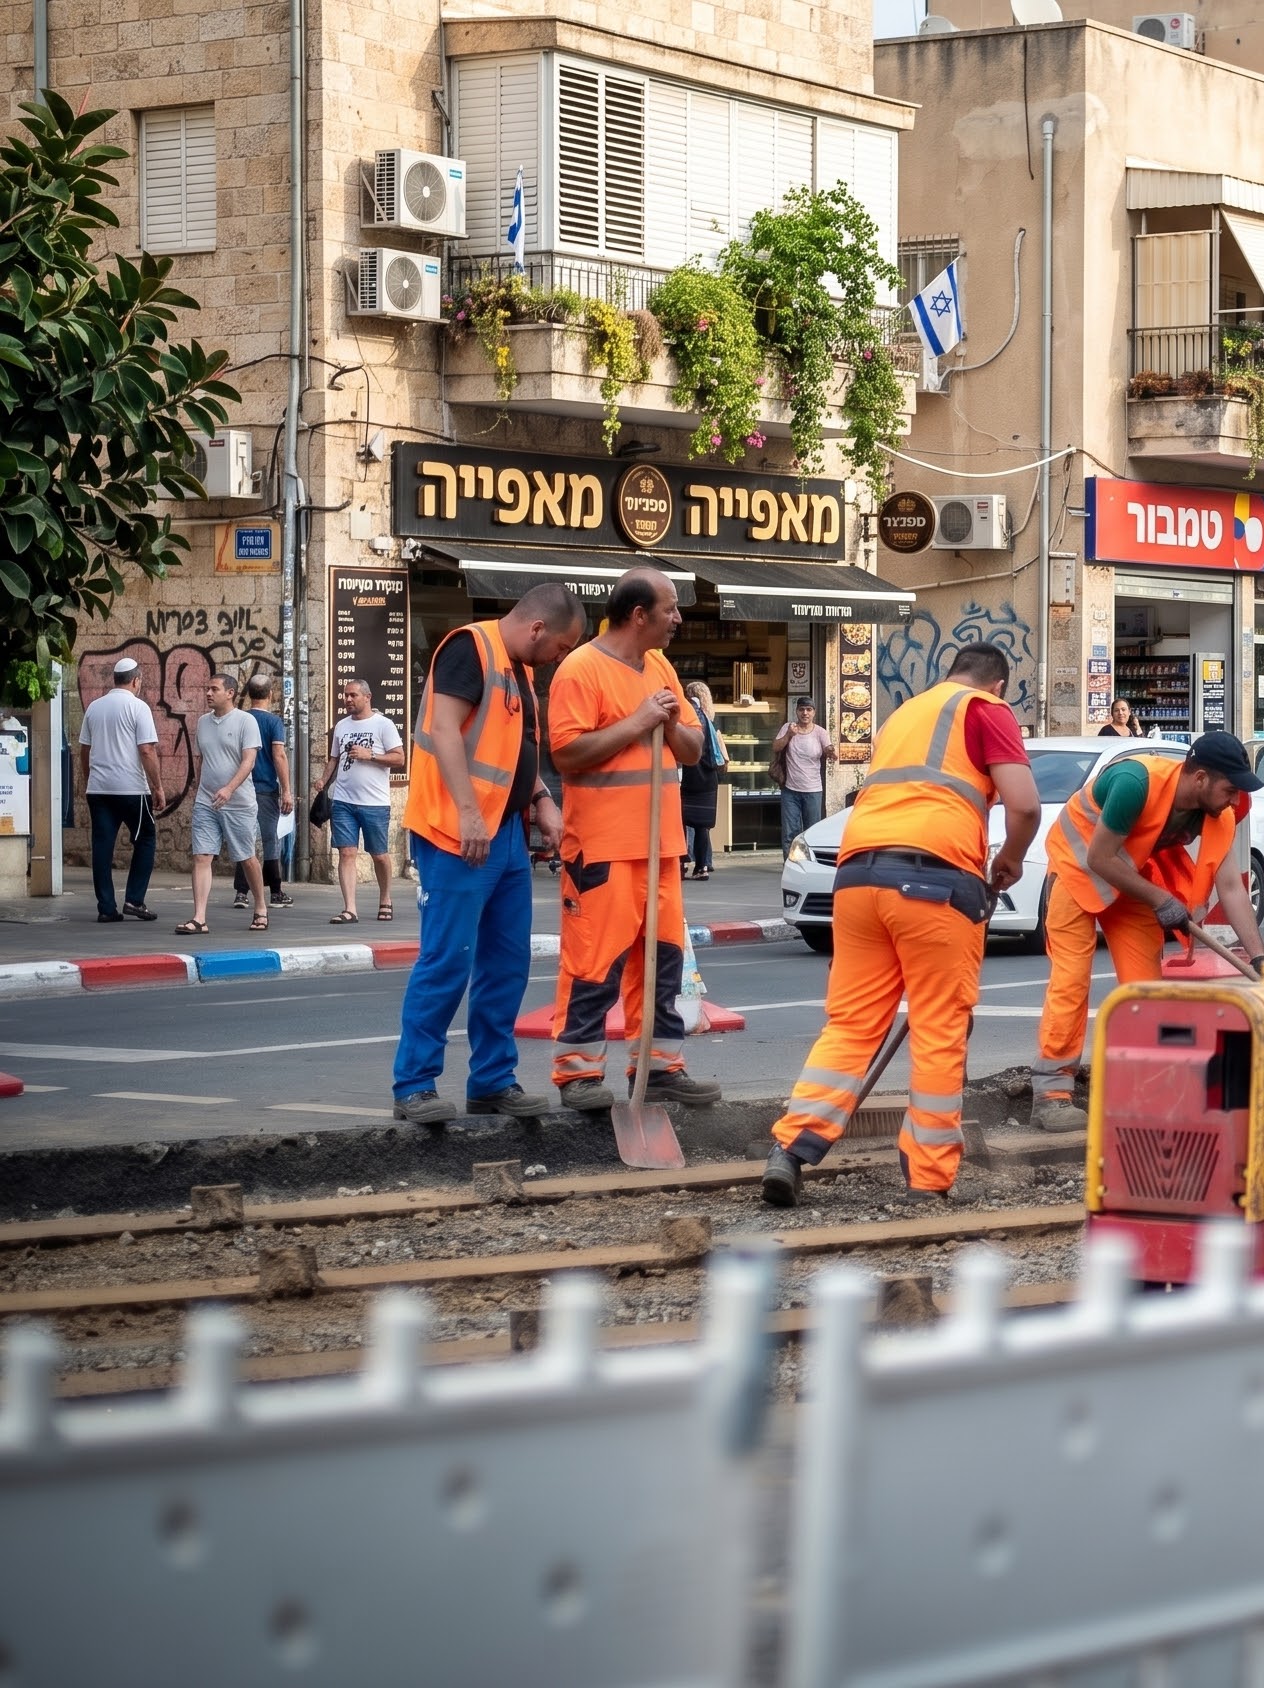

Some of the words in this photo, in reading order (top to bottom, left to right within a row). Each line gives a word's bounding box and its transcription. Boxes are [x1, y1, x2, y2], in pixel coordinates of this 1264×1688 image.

[420, 460, 604, 530] מאפייה
[687, 484, 840, 544] מאפייה
[1127, 501, 1223, 550] טמבור
